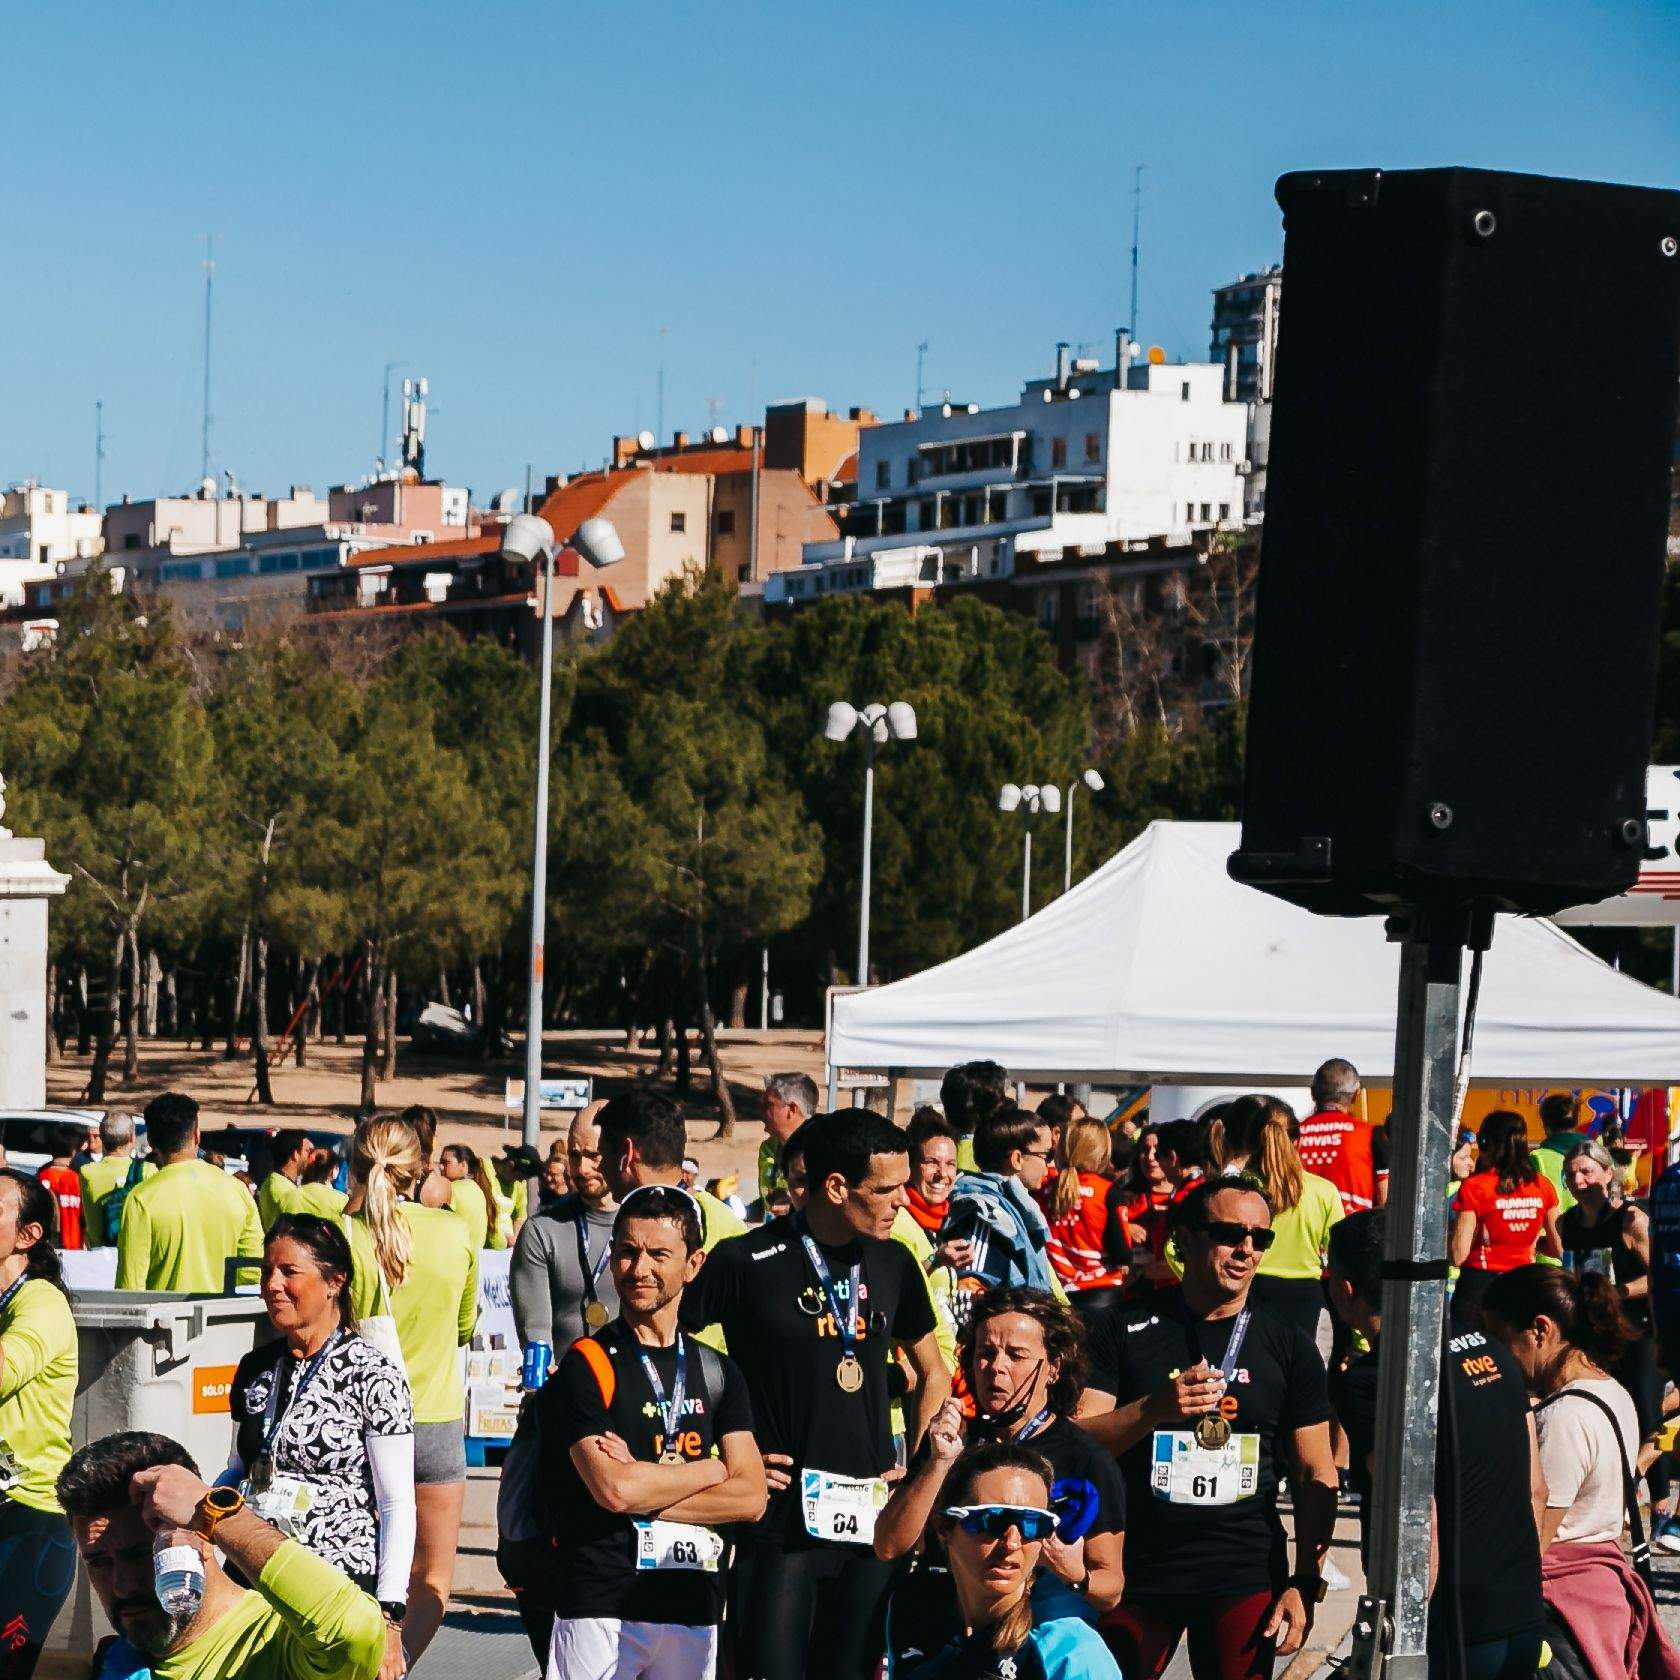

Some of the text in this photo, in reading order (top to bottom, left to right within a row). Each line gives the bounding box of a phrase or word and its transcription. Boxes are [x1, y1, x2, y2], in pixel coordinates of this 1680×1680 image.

[1495, 1196, 1544, 1210] RUNNING
[1462, 1355, 1498, 1377] rtve
[1191, 1474, 1219, 1499] 61
[833, 1512, 859, 1535] 64
[673, 1540, 698, 1564] 63
